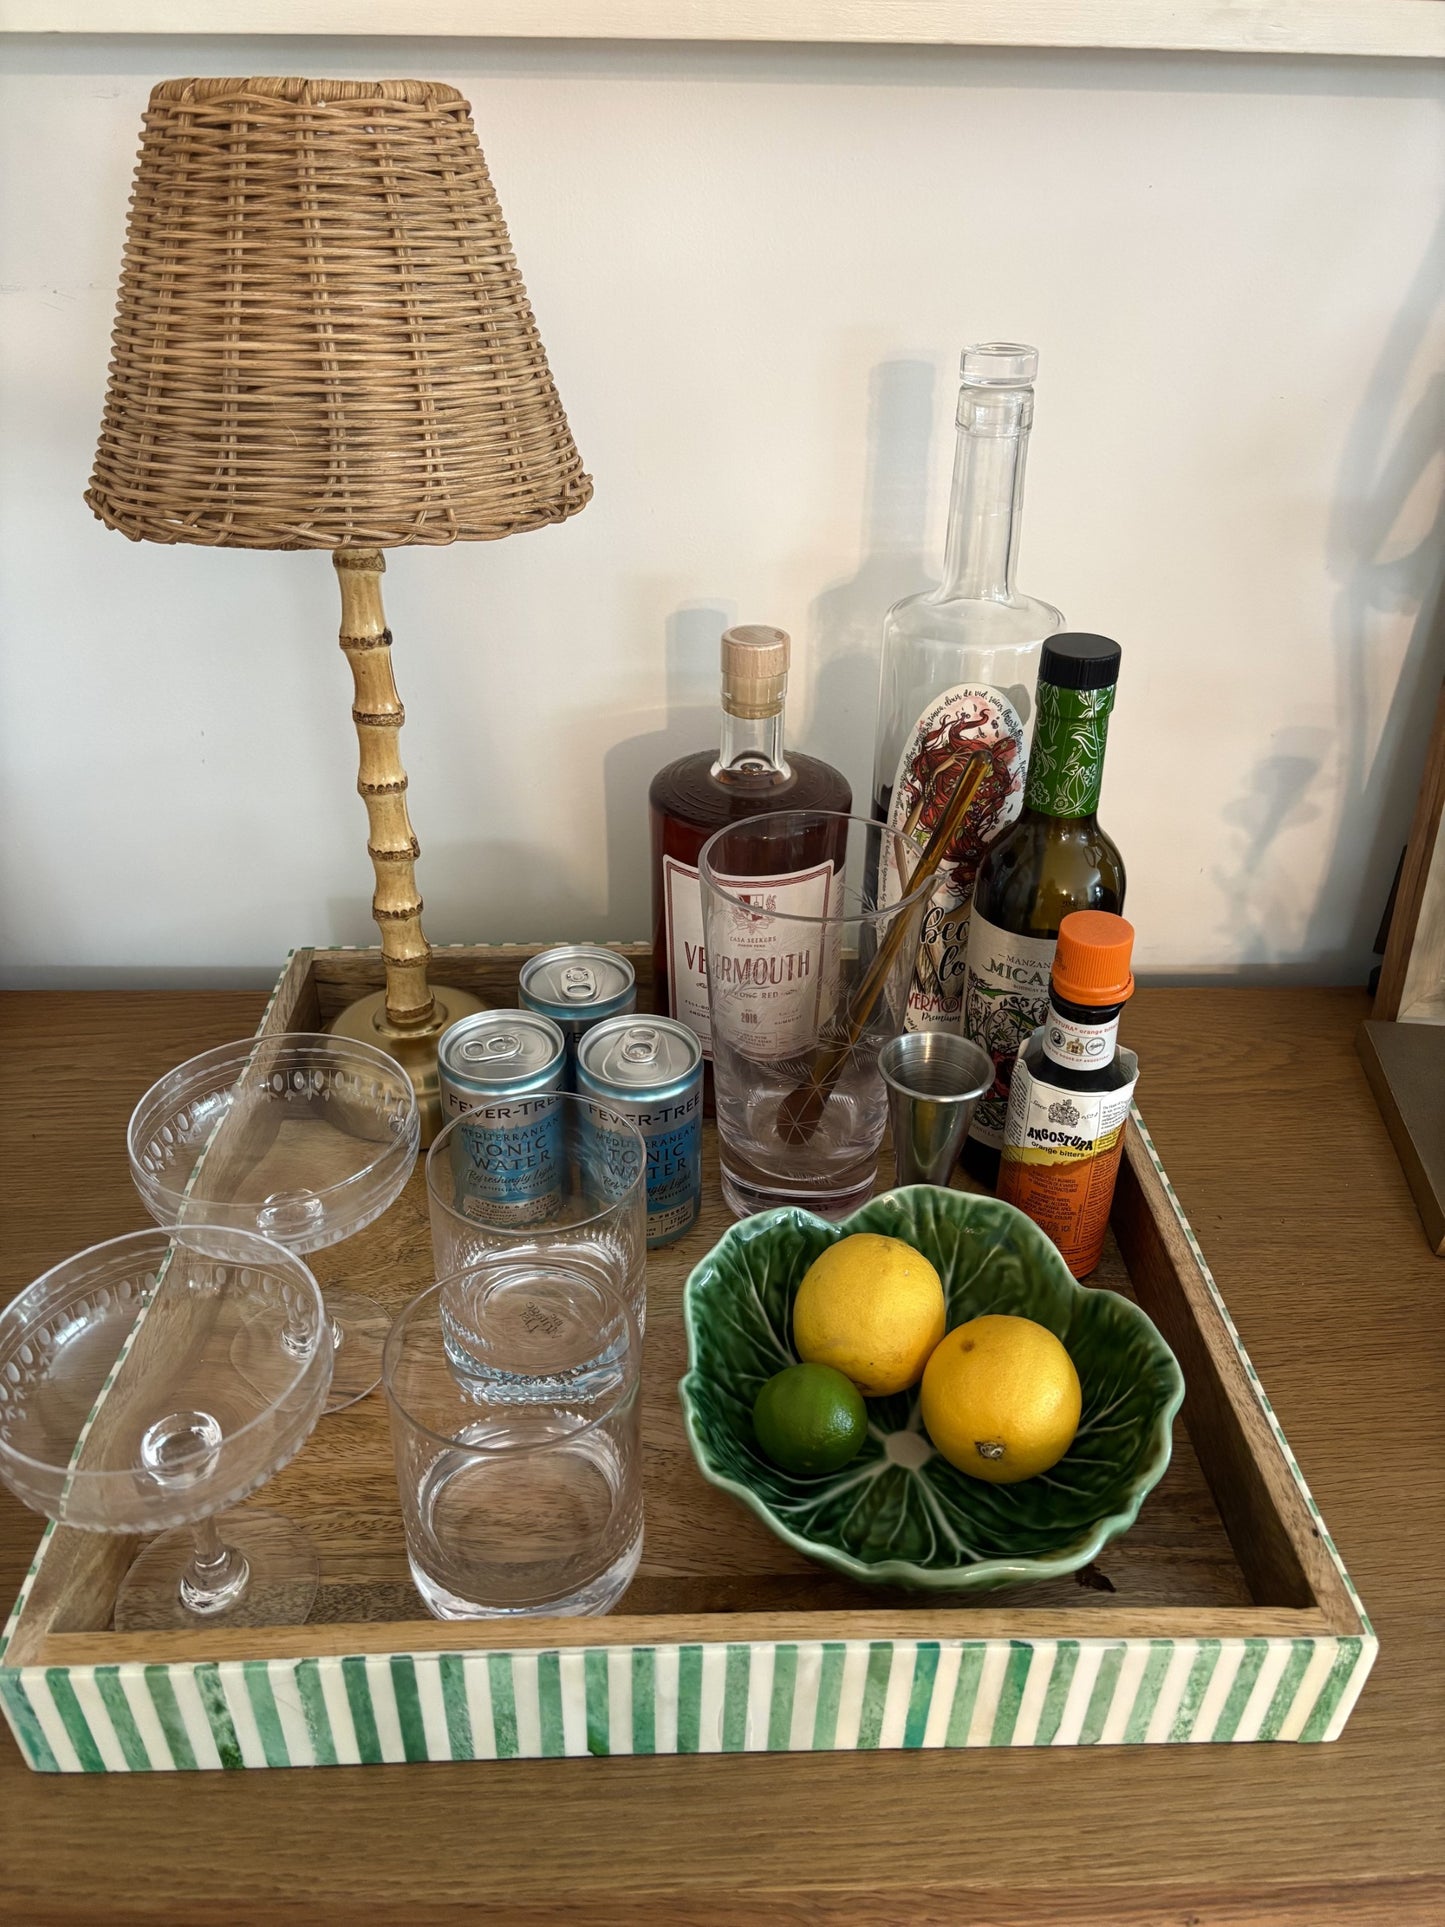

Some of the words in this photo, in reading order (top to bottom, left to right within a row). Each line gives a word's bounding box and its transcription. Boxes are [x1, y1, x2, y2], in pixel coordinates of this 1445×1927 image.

[1007, 954, 1052, 969] MANZAN
[761, 990, 779, 999] RED
[588, 1092, 700, 1129] FEVER-TREE
[461, 1117, 559, 1142] MEDITERRANEAN
[1027, 1127, 1093, 1151] ANGOSTURA
[472, 1135, 547, 1157] TONIC
[608, 1142, 685, 1164] TONIC
[1031, 1141, 1058, 1155] orange
[1060, 1150, 1085, 1158] bitters
[472, 1149, 551, 1171] WATER
[608, 1157, 687, 1179] WATER
